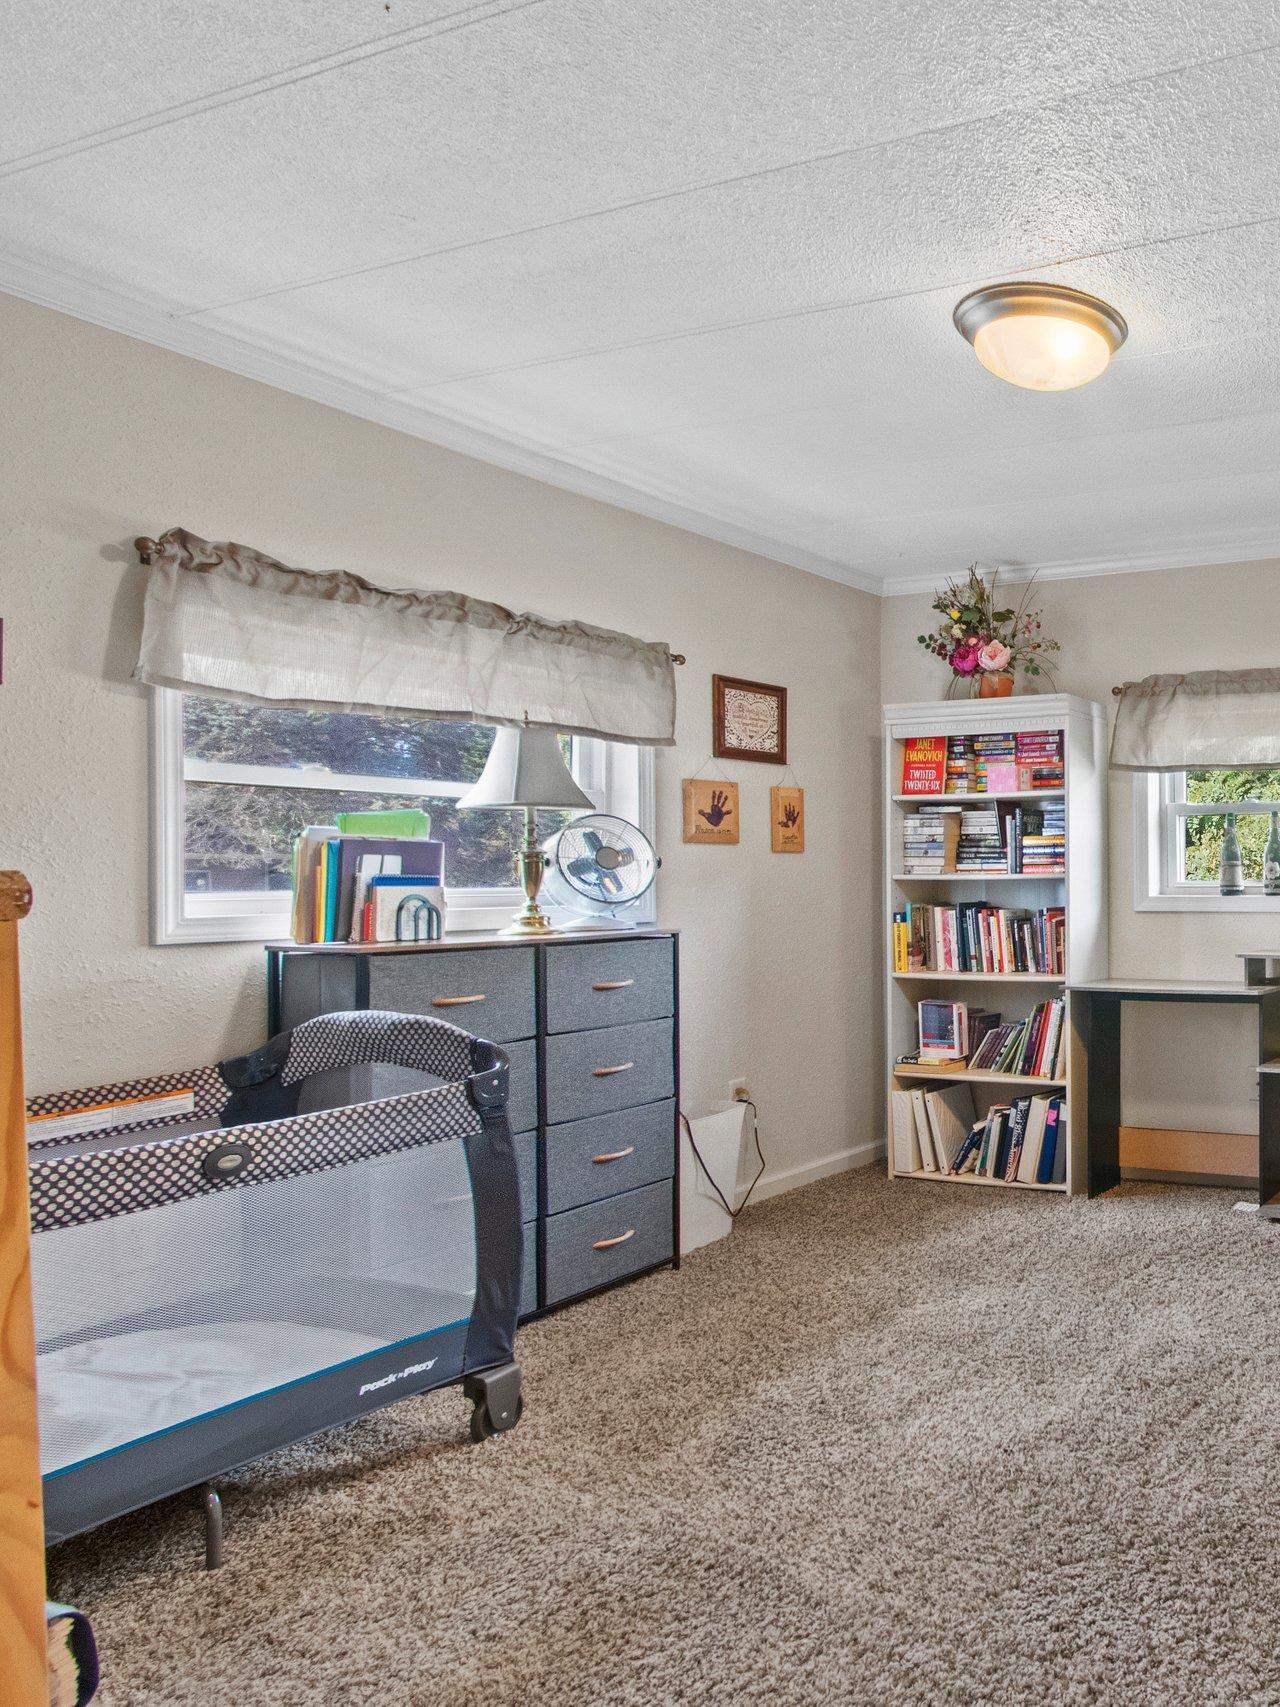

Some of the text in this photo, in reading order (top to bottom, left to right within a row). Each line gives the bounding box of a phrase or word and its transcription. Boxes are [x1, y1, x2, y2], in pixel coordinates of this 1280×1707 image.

[915, 738, 935, 750] JANET
[905, 750, 942, 762] EVANOVICH
[909, 769, 937, 780] TWISTED
[904, 780, 940, 790] TWENTY-SIX
[359, 1373, 398, 1396] Pack
[403, 1360, 435, 1378] Play
